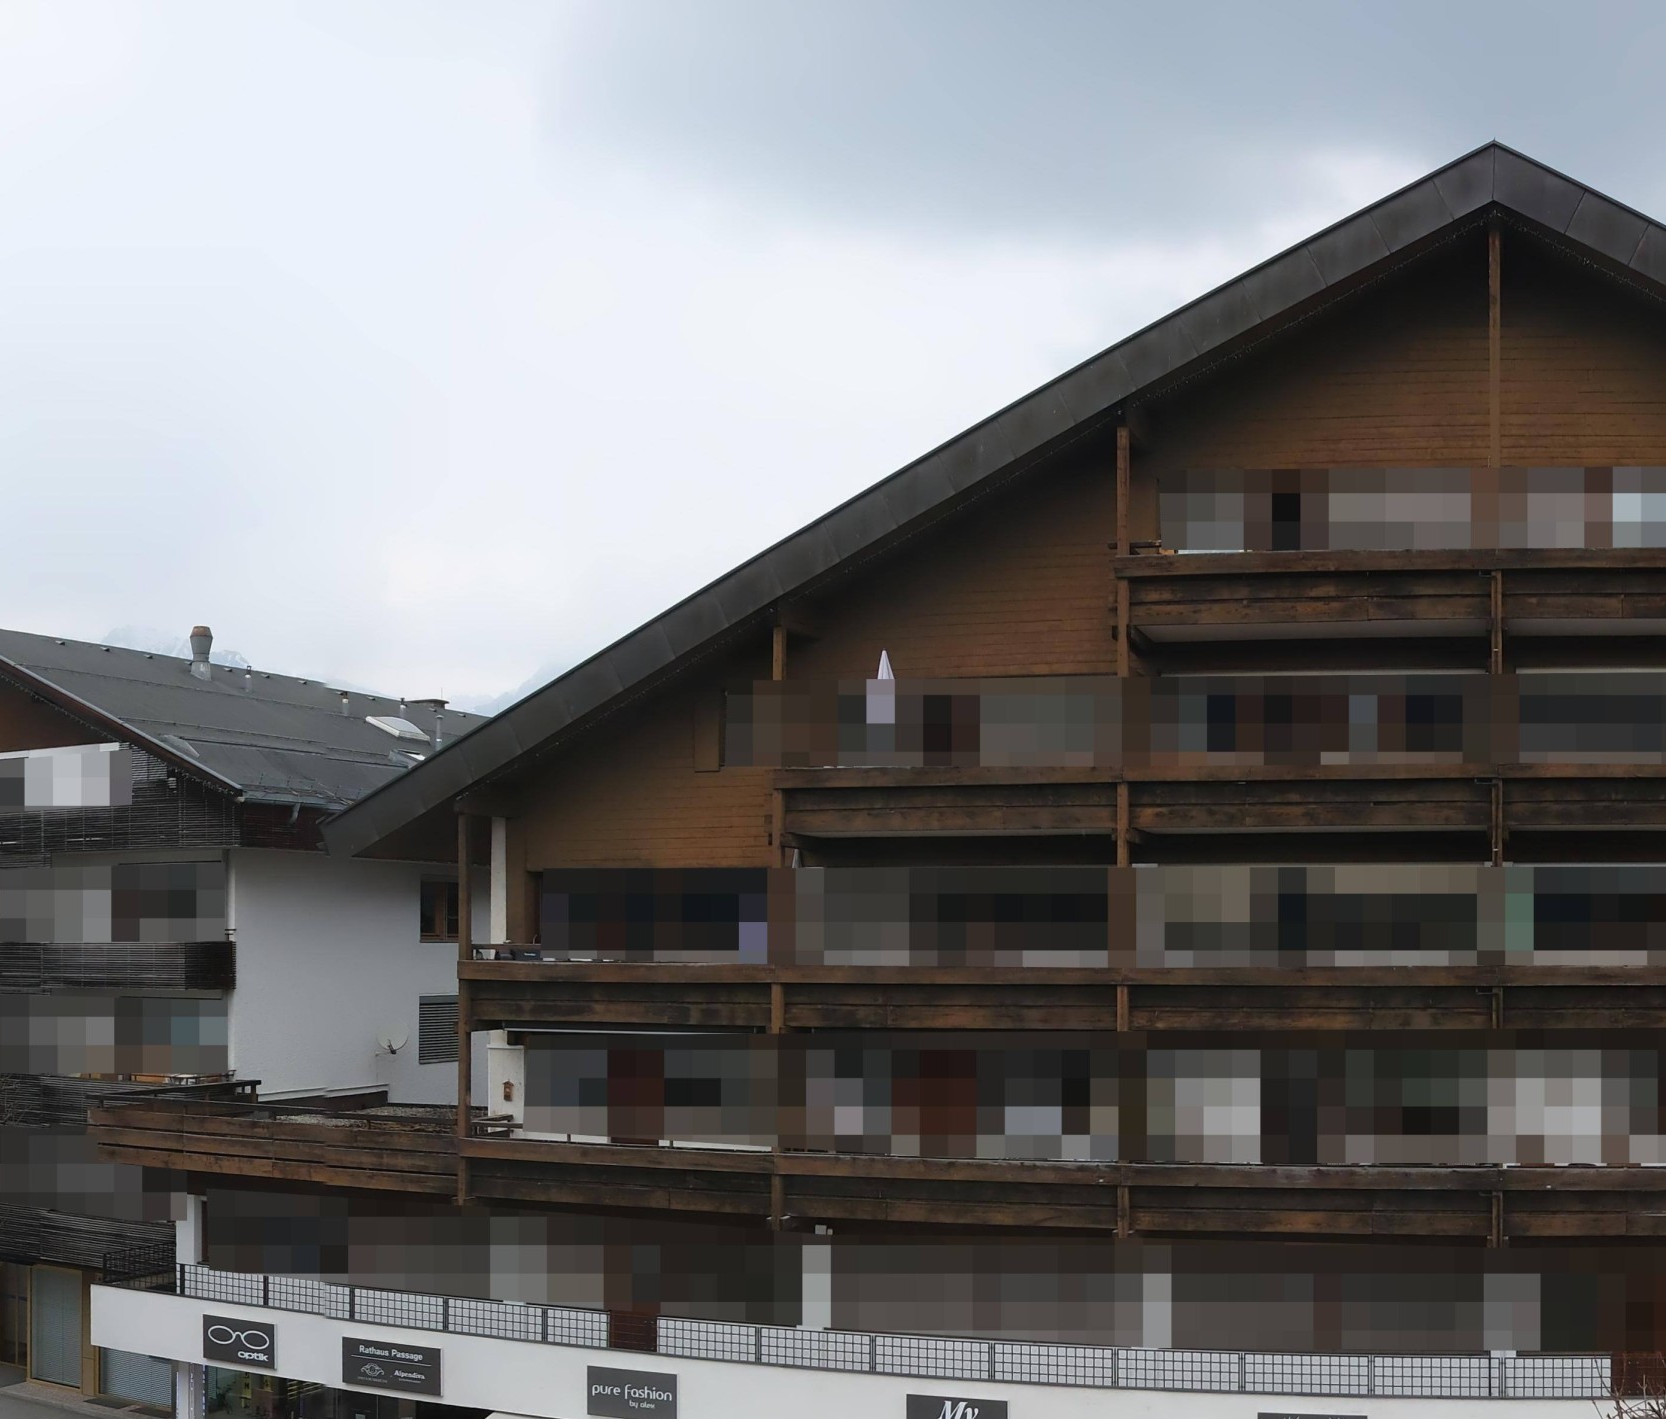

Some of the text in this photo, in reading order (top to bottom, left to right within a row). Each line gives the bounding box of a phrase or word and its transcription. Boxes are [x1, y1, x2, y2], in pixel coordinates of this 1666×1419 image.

[237, 1351, 269, 1362] optik
[359, 1345, 423, 1361] Rathaus Passage
[592, 1384, 673, 1402] pure fashion
[629, 1399, 638, 1409] by
